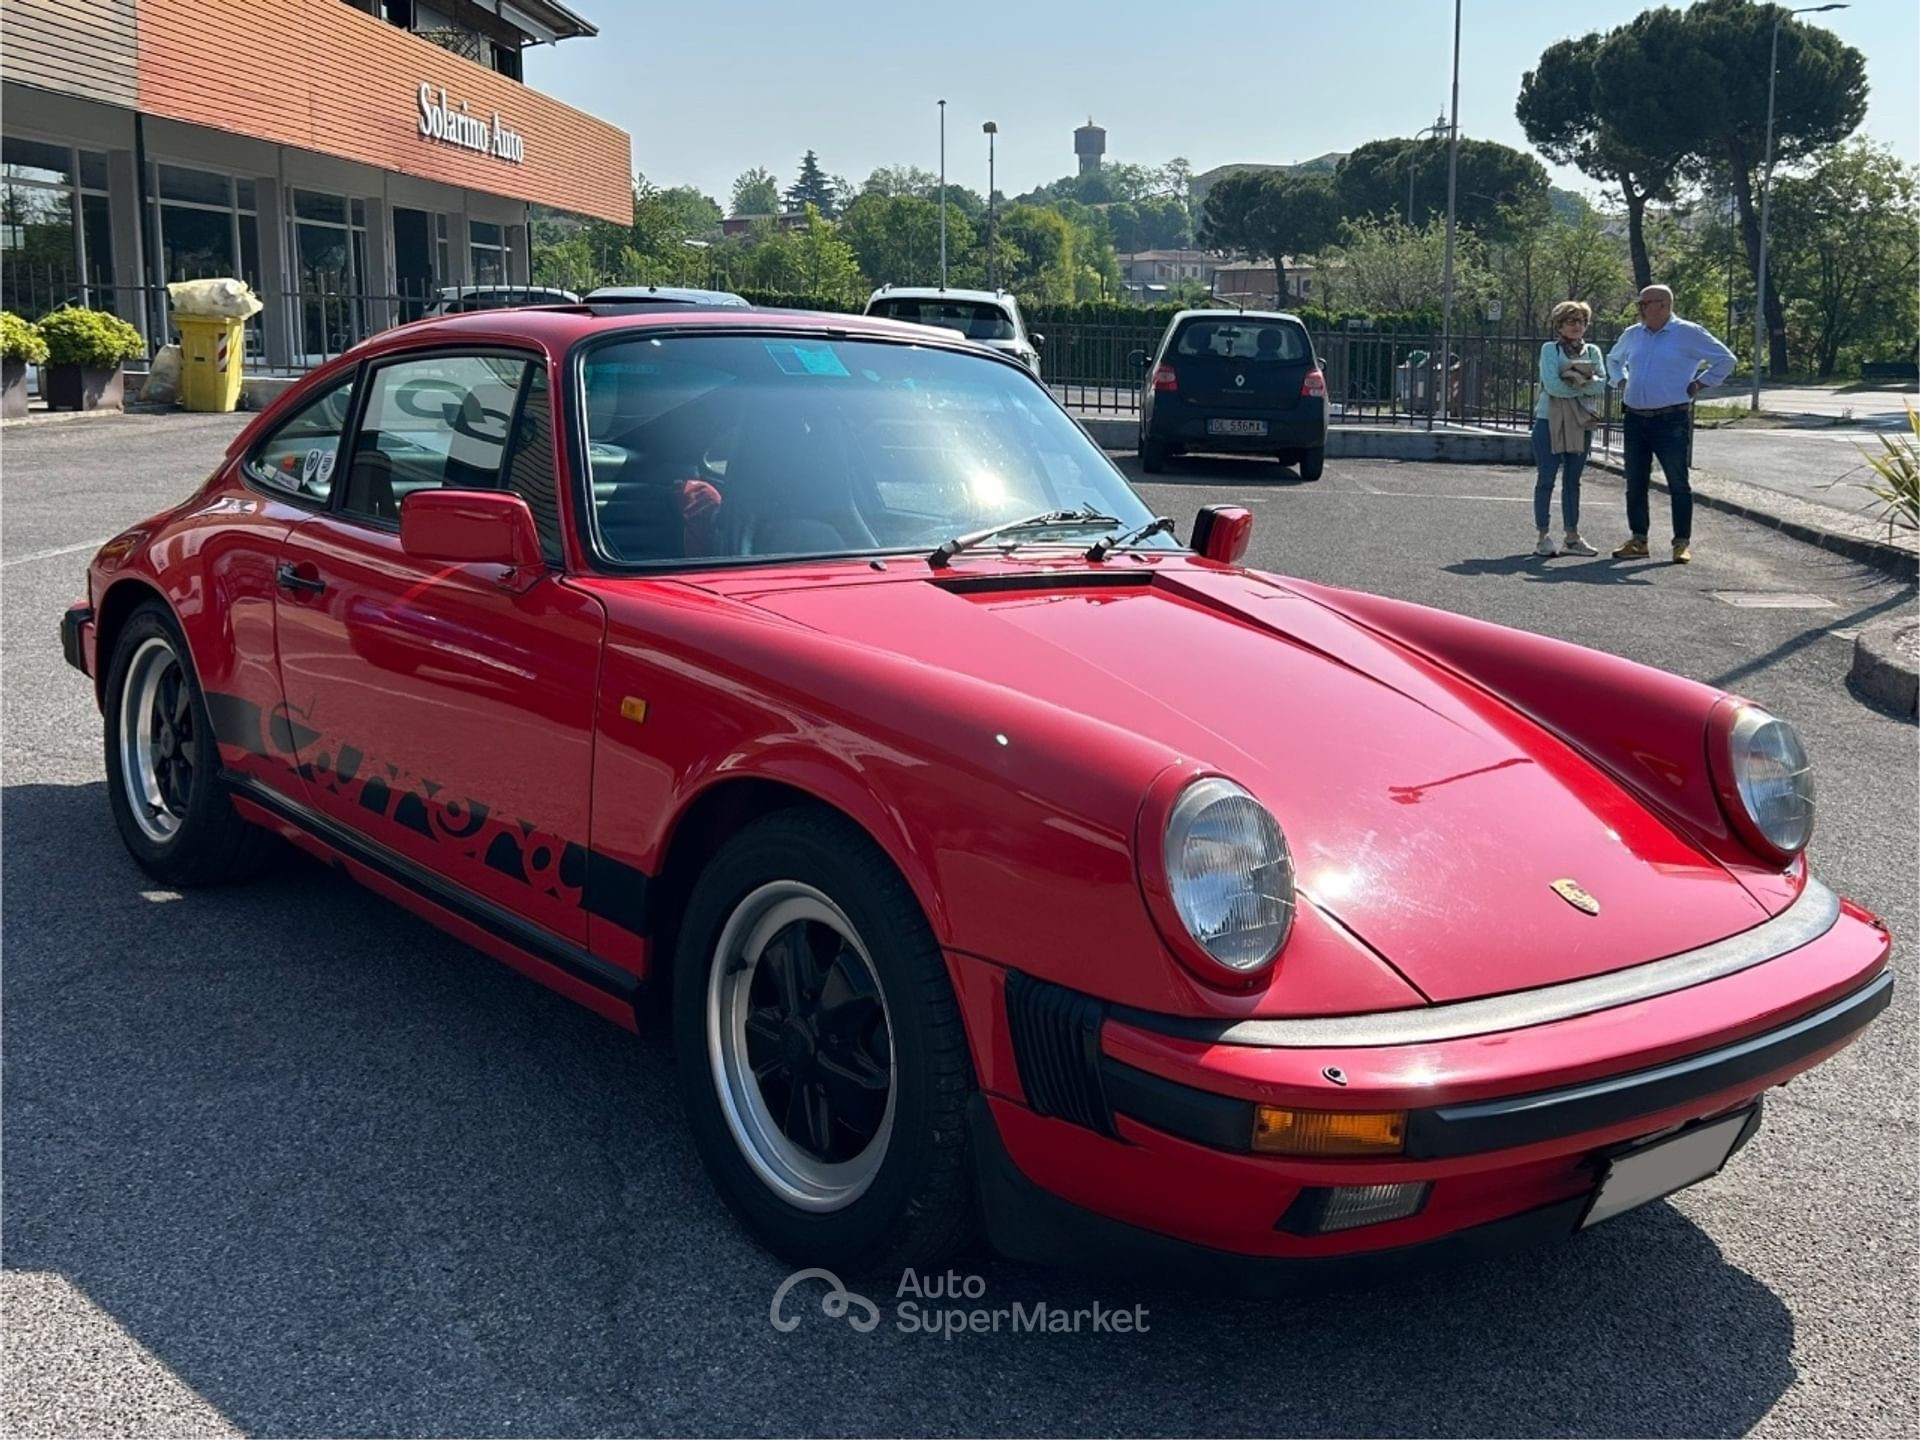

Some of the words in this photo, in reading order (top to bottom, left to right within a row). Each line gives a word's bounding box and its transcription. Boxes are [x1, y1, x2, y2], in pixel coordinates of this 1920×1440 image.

[420, 82, 488, 152] Solarino
[491, 112, 524, 163] Auto
[260, 697, 585, 907] Carrera
